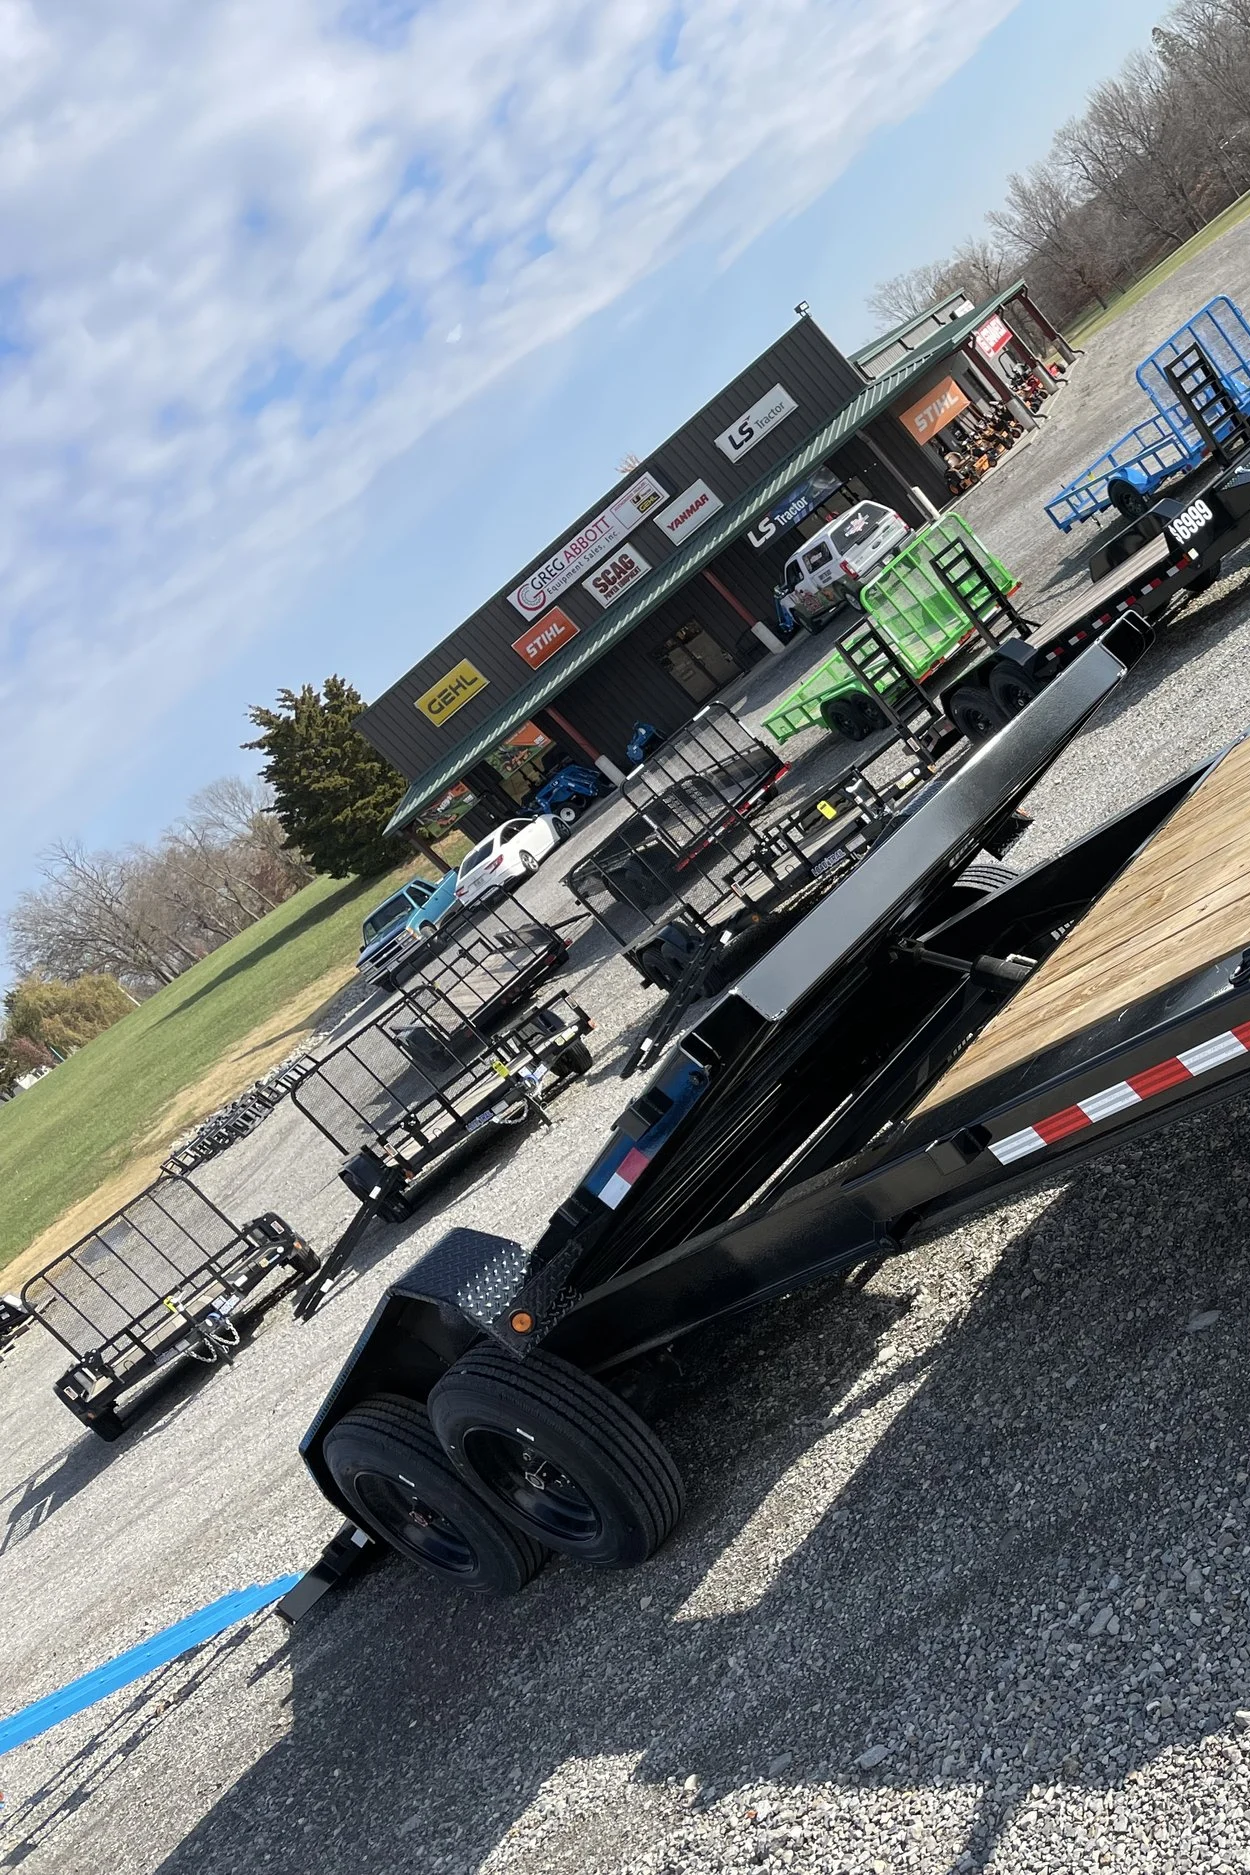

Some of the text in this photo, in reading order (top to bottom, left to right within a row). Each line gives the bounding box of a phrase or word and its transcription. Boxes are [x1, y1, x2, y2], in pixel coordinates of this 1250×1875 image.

[728, 401, 785, 450] LS Tractor
[914, 390, 959, 433] STIHL
[640, 494, 658, 511] GEHL
[667, 493, 709, 532] YANMAR
[747, 516, 776, 548] LS
[774, 496, 808, 526] Tractor
[1169, 499, 1213, 545] $6999
[531, 515, 611, 590] GREG ABBOTT
[546, 530, 620, 595] Equipment Sales, Inc.
[592, 553, 635, 594] SCAG
[603, 567, 642, 600] POWER EQUIPMENT
[525, 623, 565, 658] STIHL
[428, 674, 478, 715] GEHL
